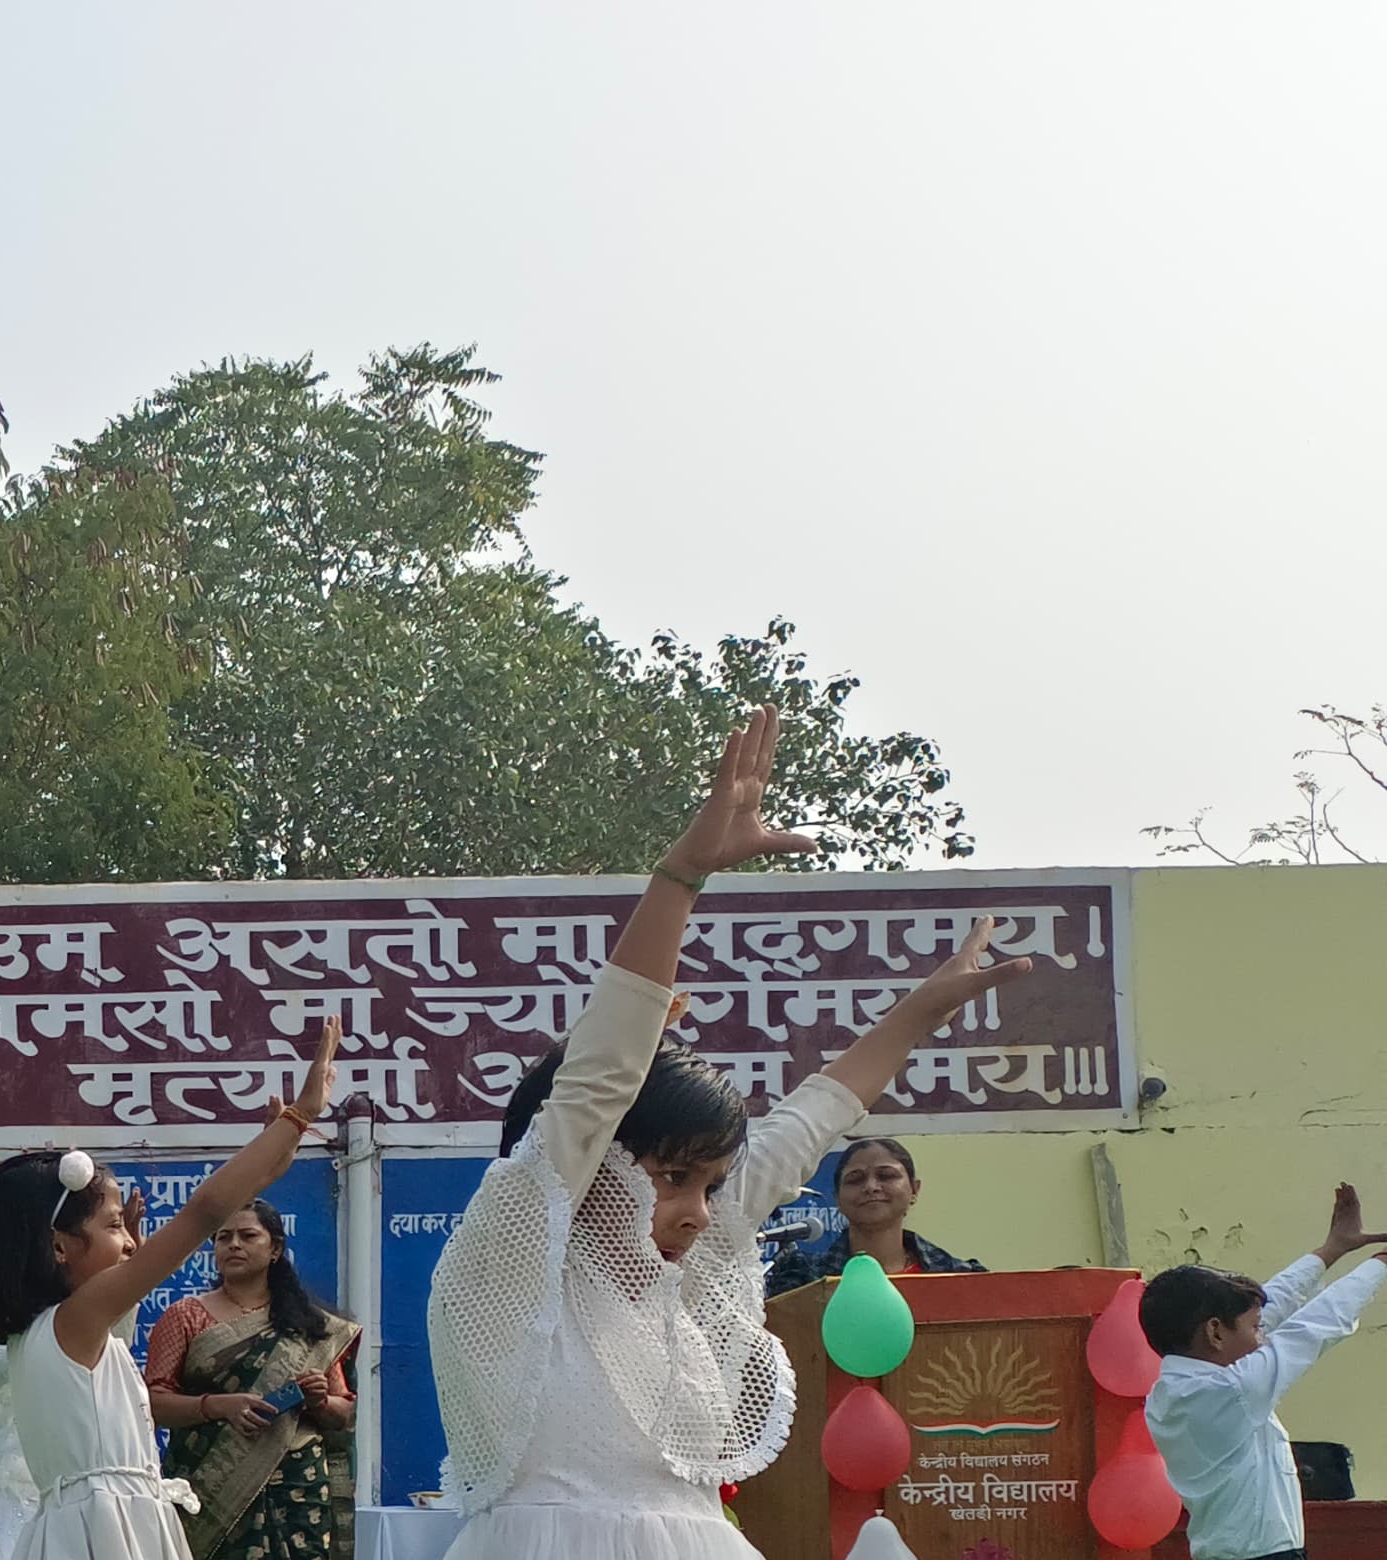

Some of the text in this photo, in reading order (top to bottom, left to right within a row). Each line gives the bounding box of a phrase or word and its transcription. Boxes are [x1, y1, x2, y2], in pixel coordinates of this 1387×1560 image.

[156, 899, 477, 986] असतो
[493, 914, 618, 978] मा
[259, 987, 389, 1053] मा
[917, 1451, 1050, 1470] केन्द्रीय विद्यालय संगठन
[897, 1472, 1079, 1506] केन्द्रीय विद्यालय
[994, 1507, 1028, 1520] नगर
